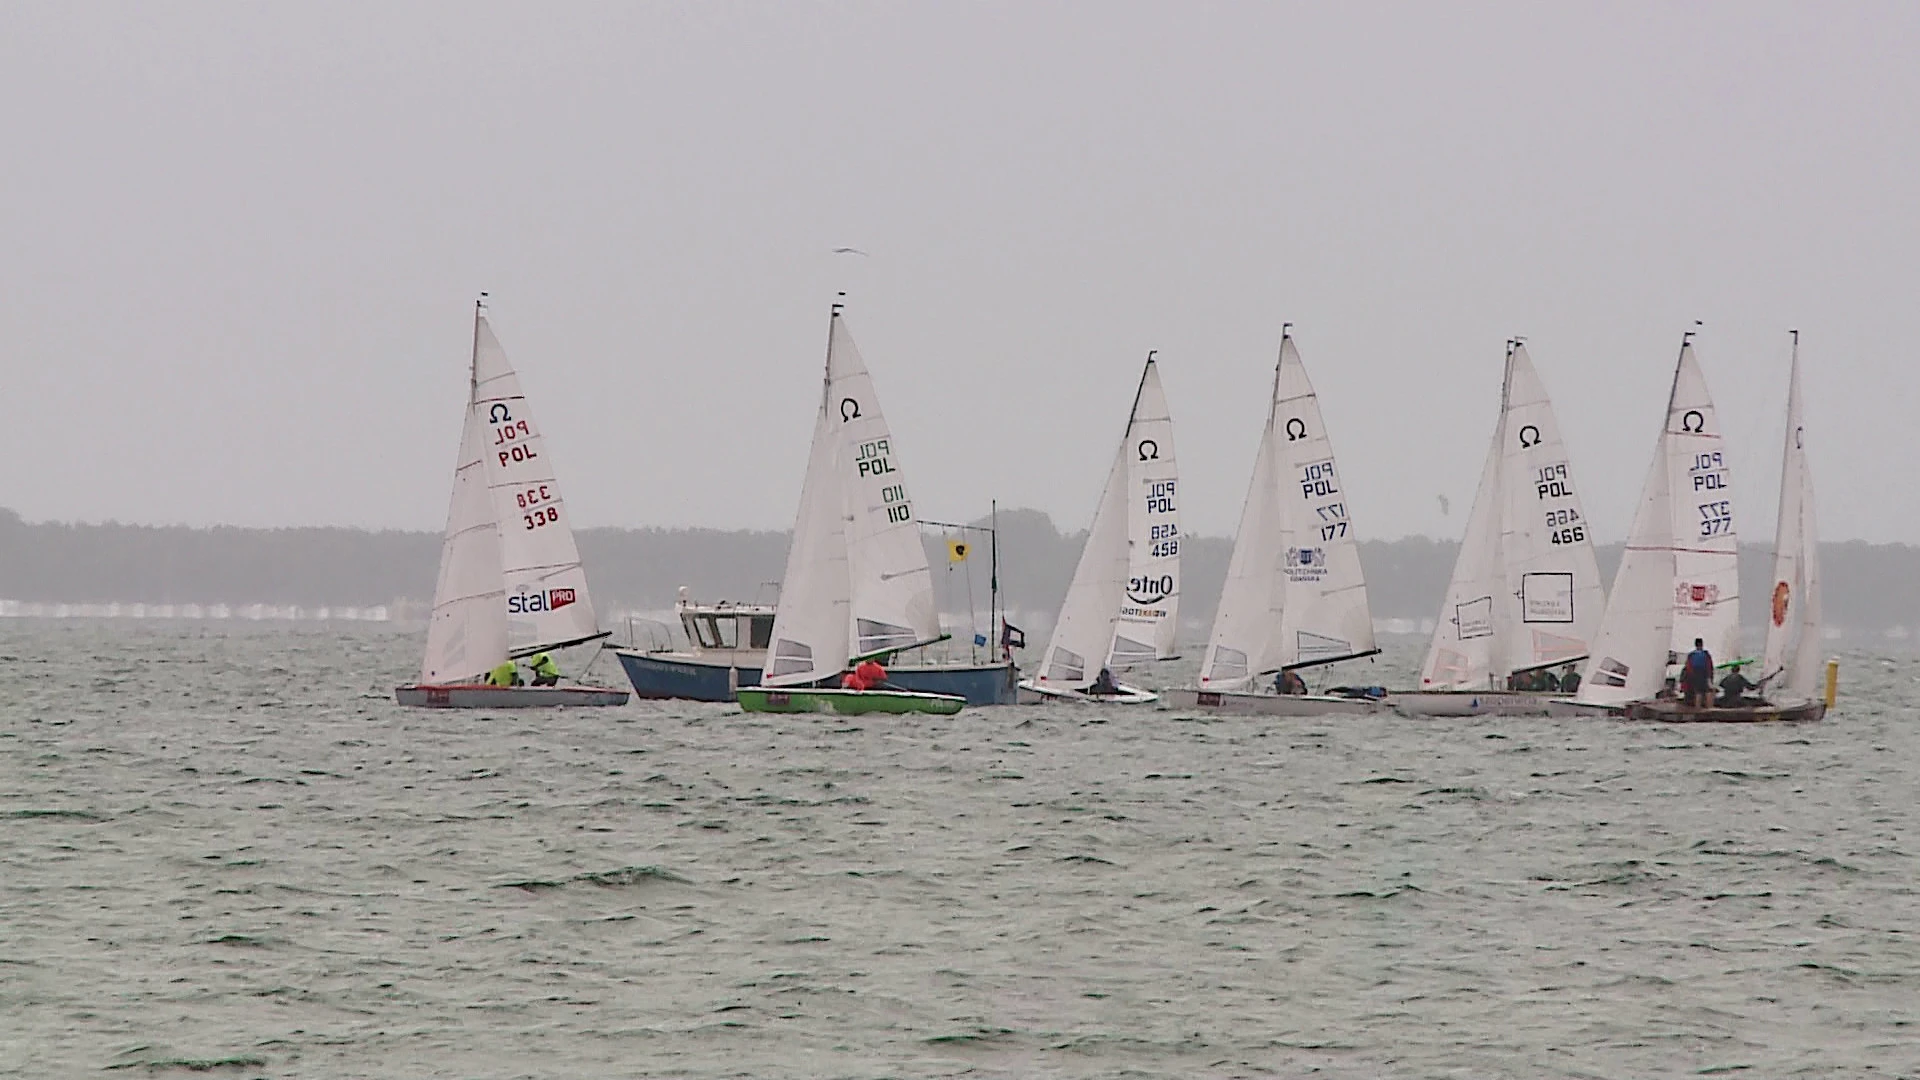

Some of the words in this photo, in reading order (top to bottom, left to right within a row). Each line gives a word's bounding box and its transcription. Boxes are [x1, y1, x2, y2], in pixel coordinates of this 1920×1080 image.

[499, 444, 537, 467] POL
[858, 457, 896, 478] POL
[1303, 480, 1338, 499] POL
[1538, 482, 1572, 499] POL
[1694, 474, 1727, 491] POL
[887, 504, 910, 523] 110
[1148, 498, 1176, 513] POL
[524, 507, 558, 530] 338
[1701, 517, 1731, 535] 377
[1321, 522, 1347, 541] 177
[1551, 527, 1584, 545] 466
[1151, 540, 1178, 557] 458
[508, 590, 549, 613] stal
[552, 590, 574, 603] PRO
